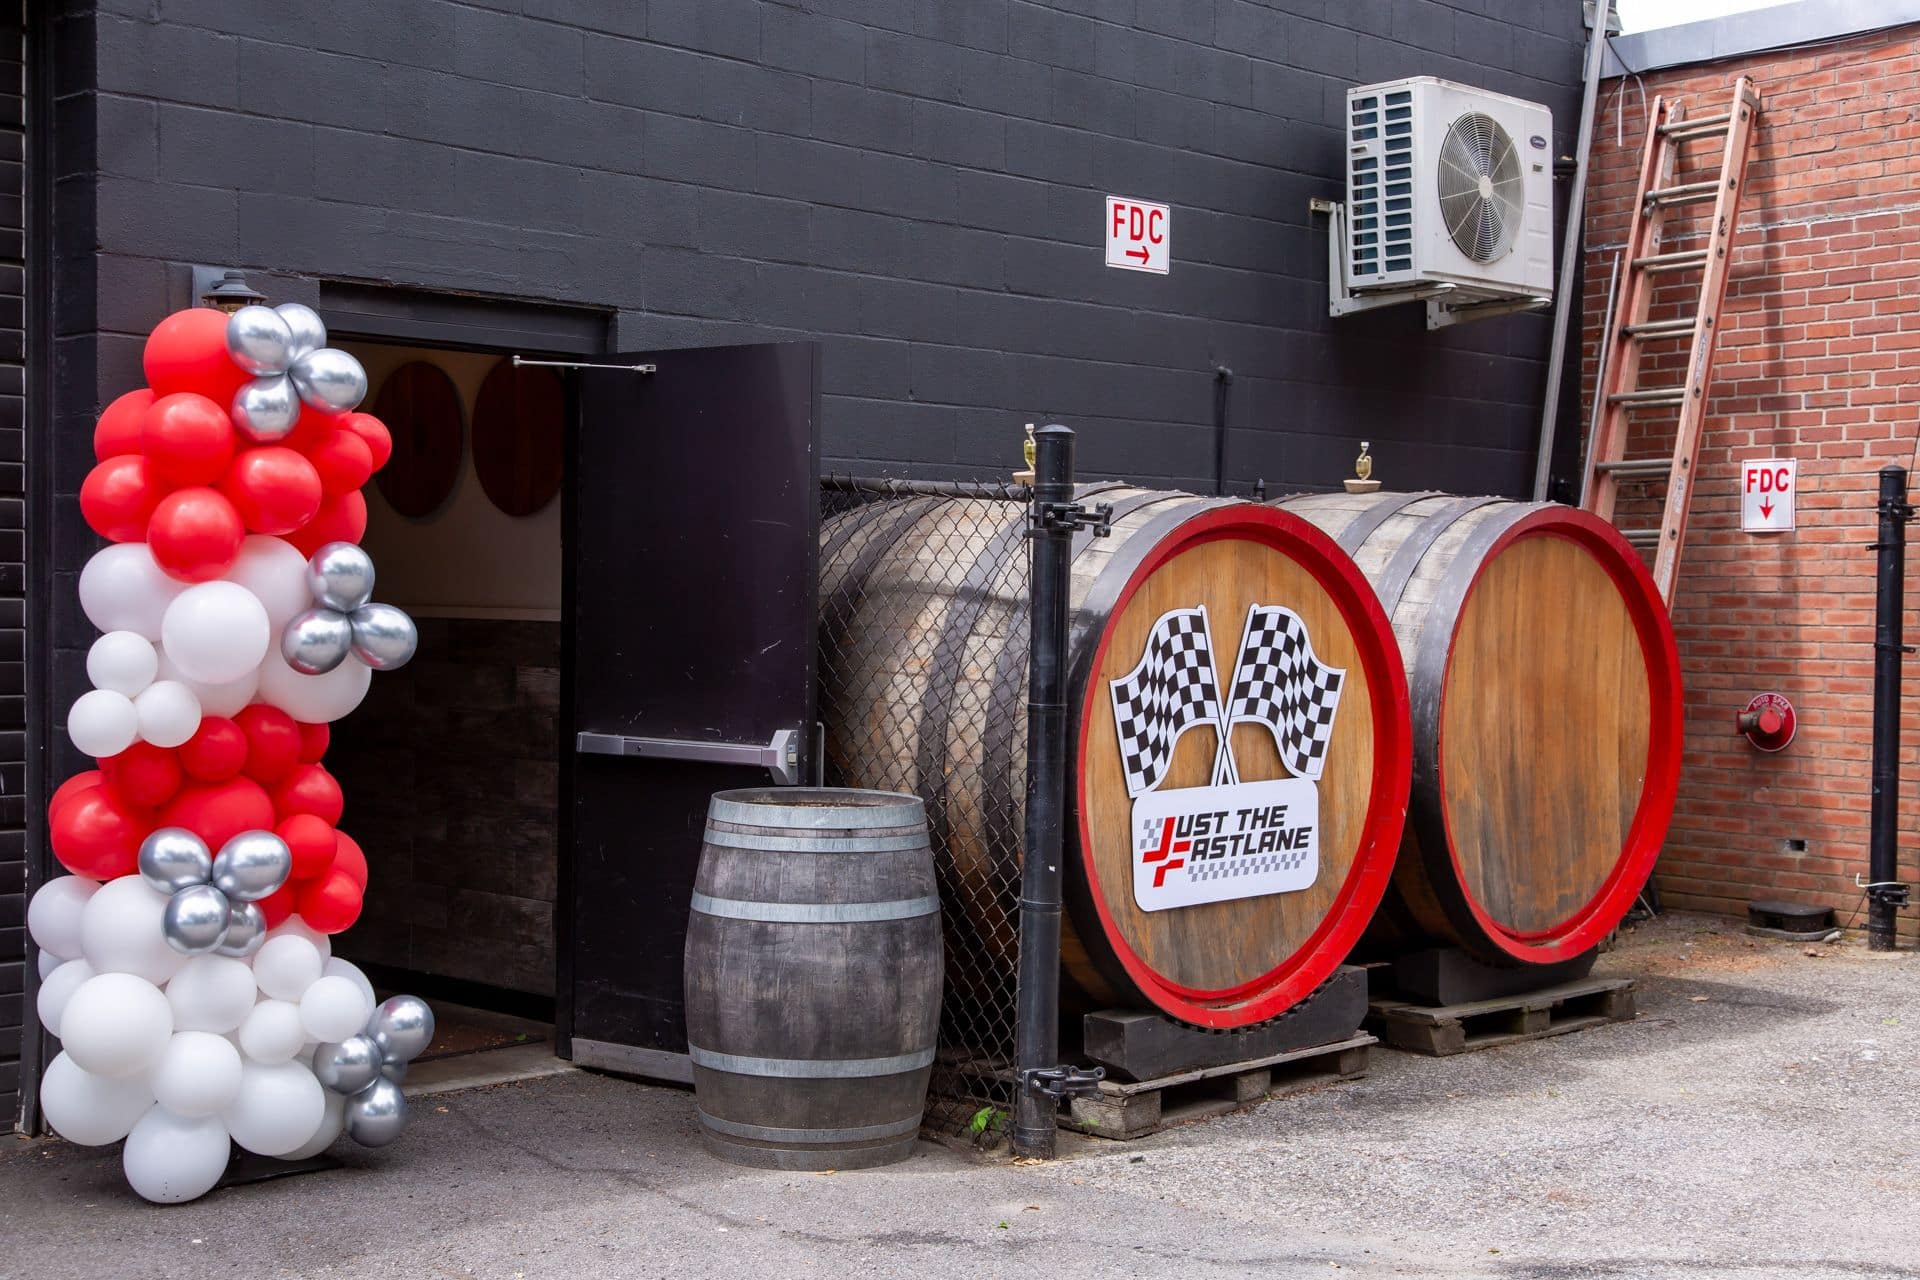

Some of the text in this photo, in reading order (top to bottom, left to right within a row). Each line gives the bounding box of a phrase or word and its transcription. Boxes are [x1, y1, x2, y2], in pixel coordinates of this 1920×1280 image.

[1113, 203, 1163, 244] FDC
[1746, 467, 1789, 493] FDC
[1236, 805, 1288, 831] THE
